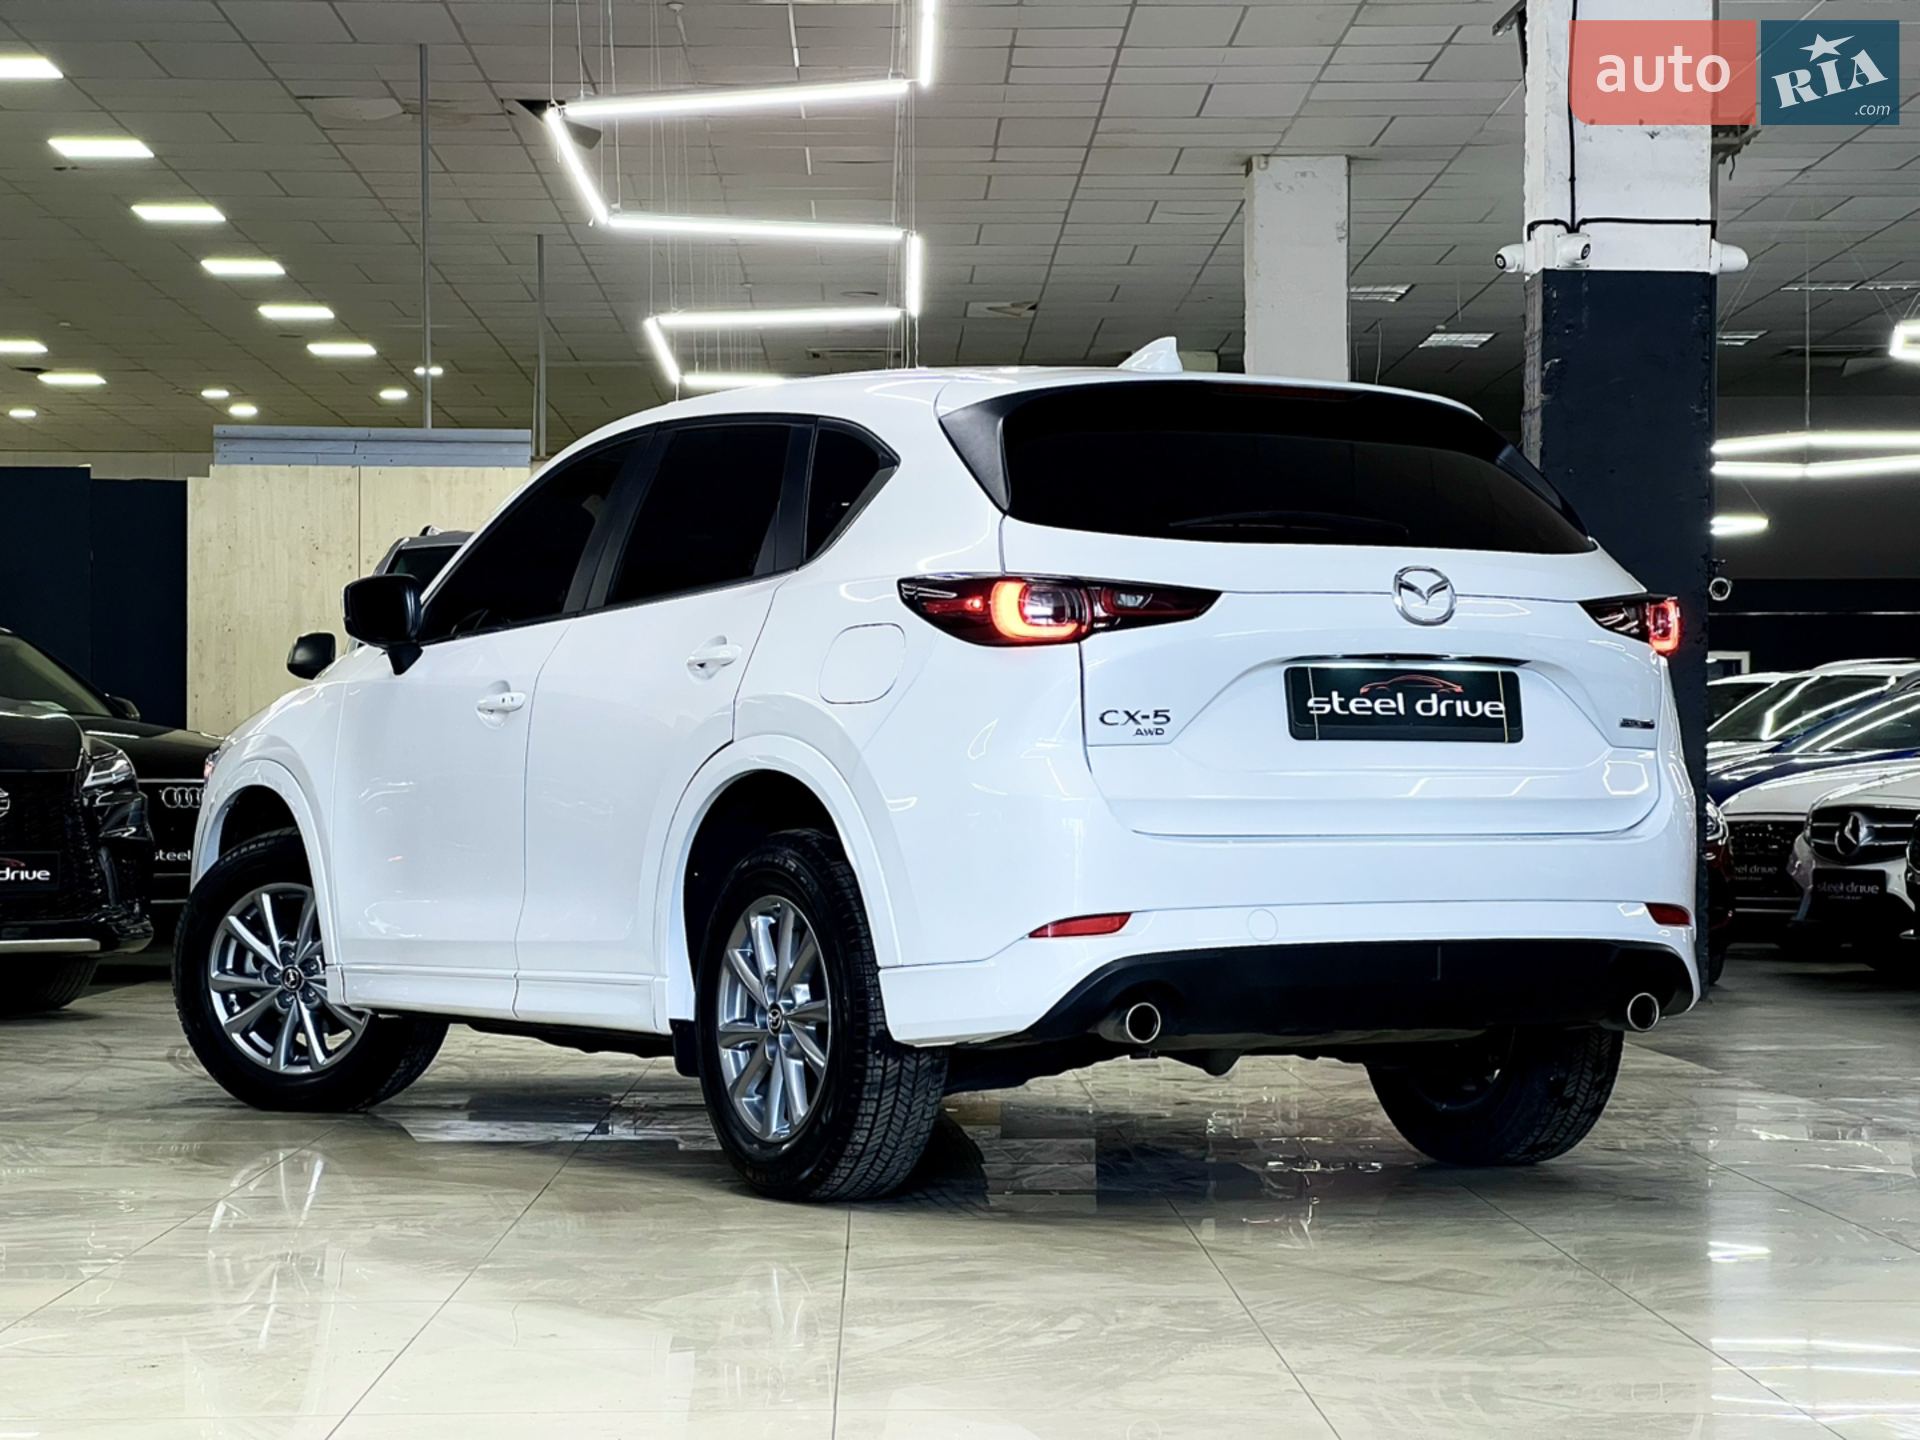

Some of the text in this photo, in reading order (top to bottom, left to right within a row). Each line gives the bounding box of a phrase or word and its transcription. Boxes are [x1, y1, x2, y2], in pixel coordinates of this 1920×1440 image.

[1307, 690, 1506, 718] steel drive
[1098, 709, 1172, 726] CX-5
[1132, 727, 1165, 737] AWD
[0, 867, 51, 881] drive
